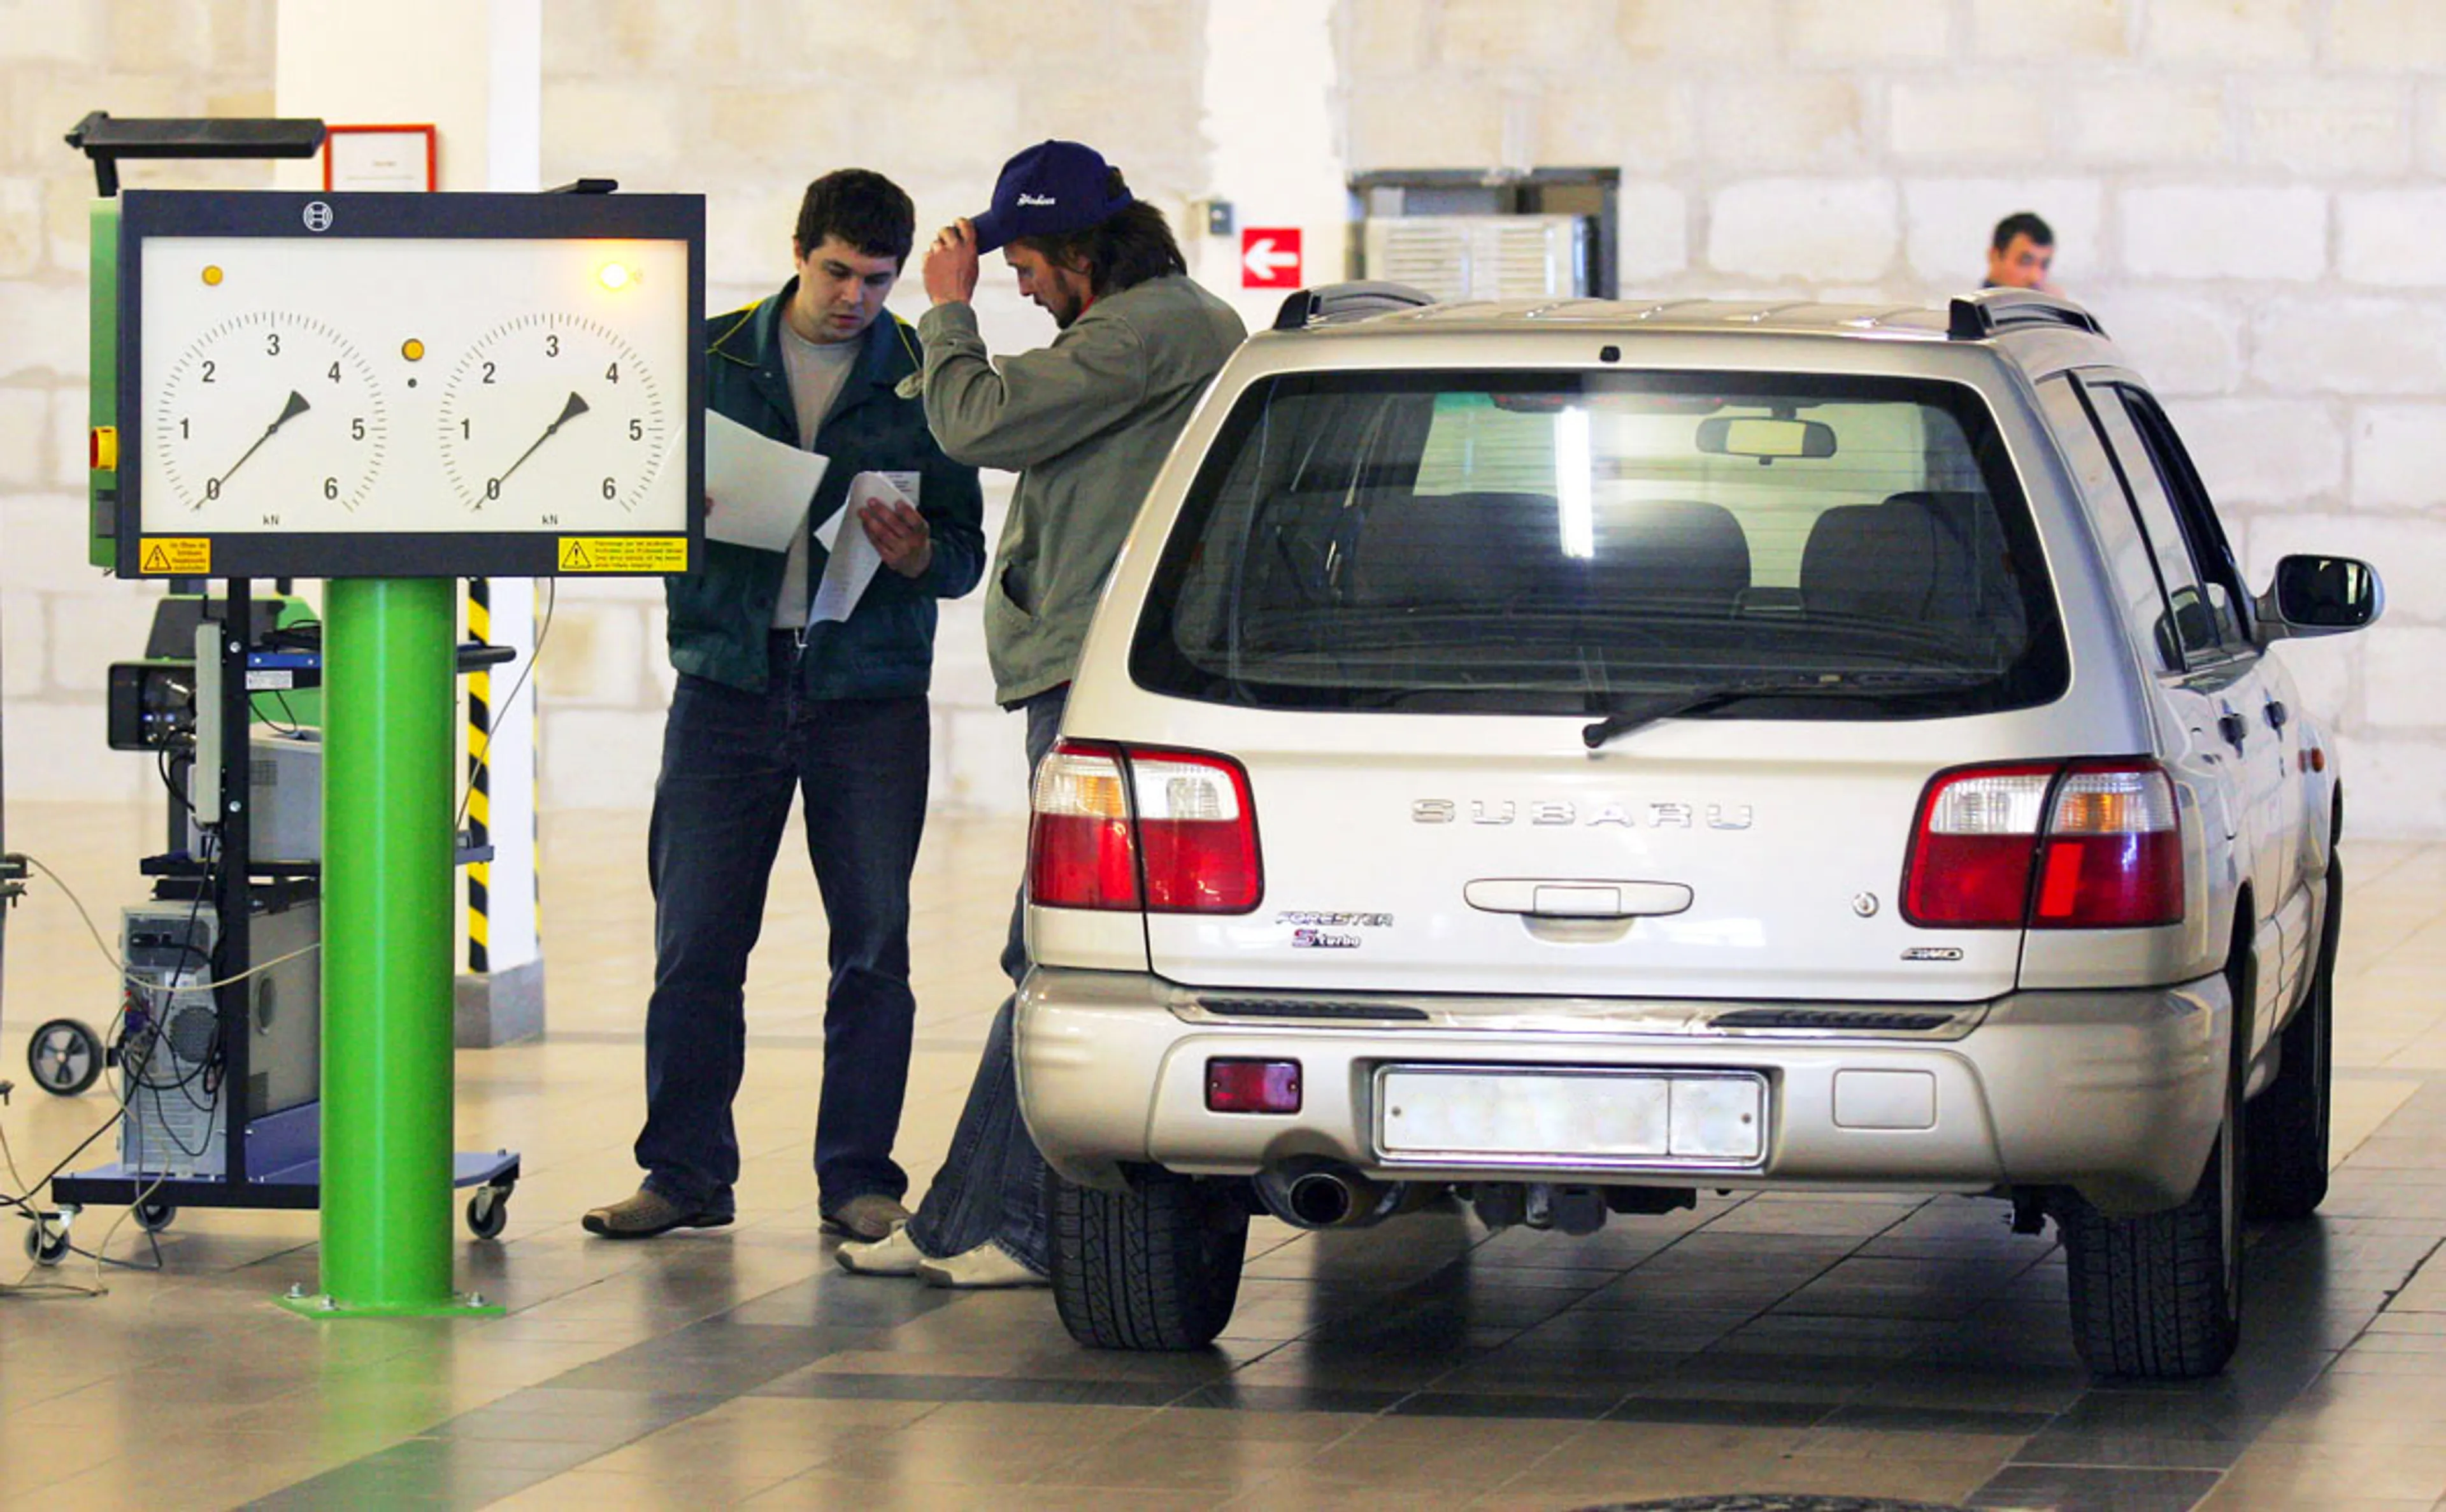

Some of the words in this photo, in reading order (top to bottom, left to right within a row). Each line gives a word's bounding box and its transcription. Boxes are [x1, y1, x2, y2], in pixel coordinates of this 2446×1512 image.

[267, 334, 280, 356] 3
[546, 335, 559, 357] 3
[203, 360, 215, 383] 2
[328, 362, 341, 383] 4
[483, 362, 495, 384] 2
[606, 362, 619, 384] 4
[180, 418, 189, 439] 1
[352, 418, 364, 440] 5
[461, 419, 469, 439] 1
[629, 419, 642, 441] 5
[206, 478, 220, 500] 0
[324, 477, 338, 499] 6
[487, 478, 501, 500] 0
[603, 477, 616, 499] 6
[1412, 799, 1753, 829] SUBARU
[1275, 911, 1394, 927] FORESTER
